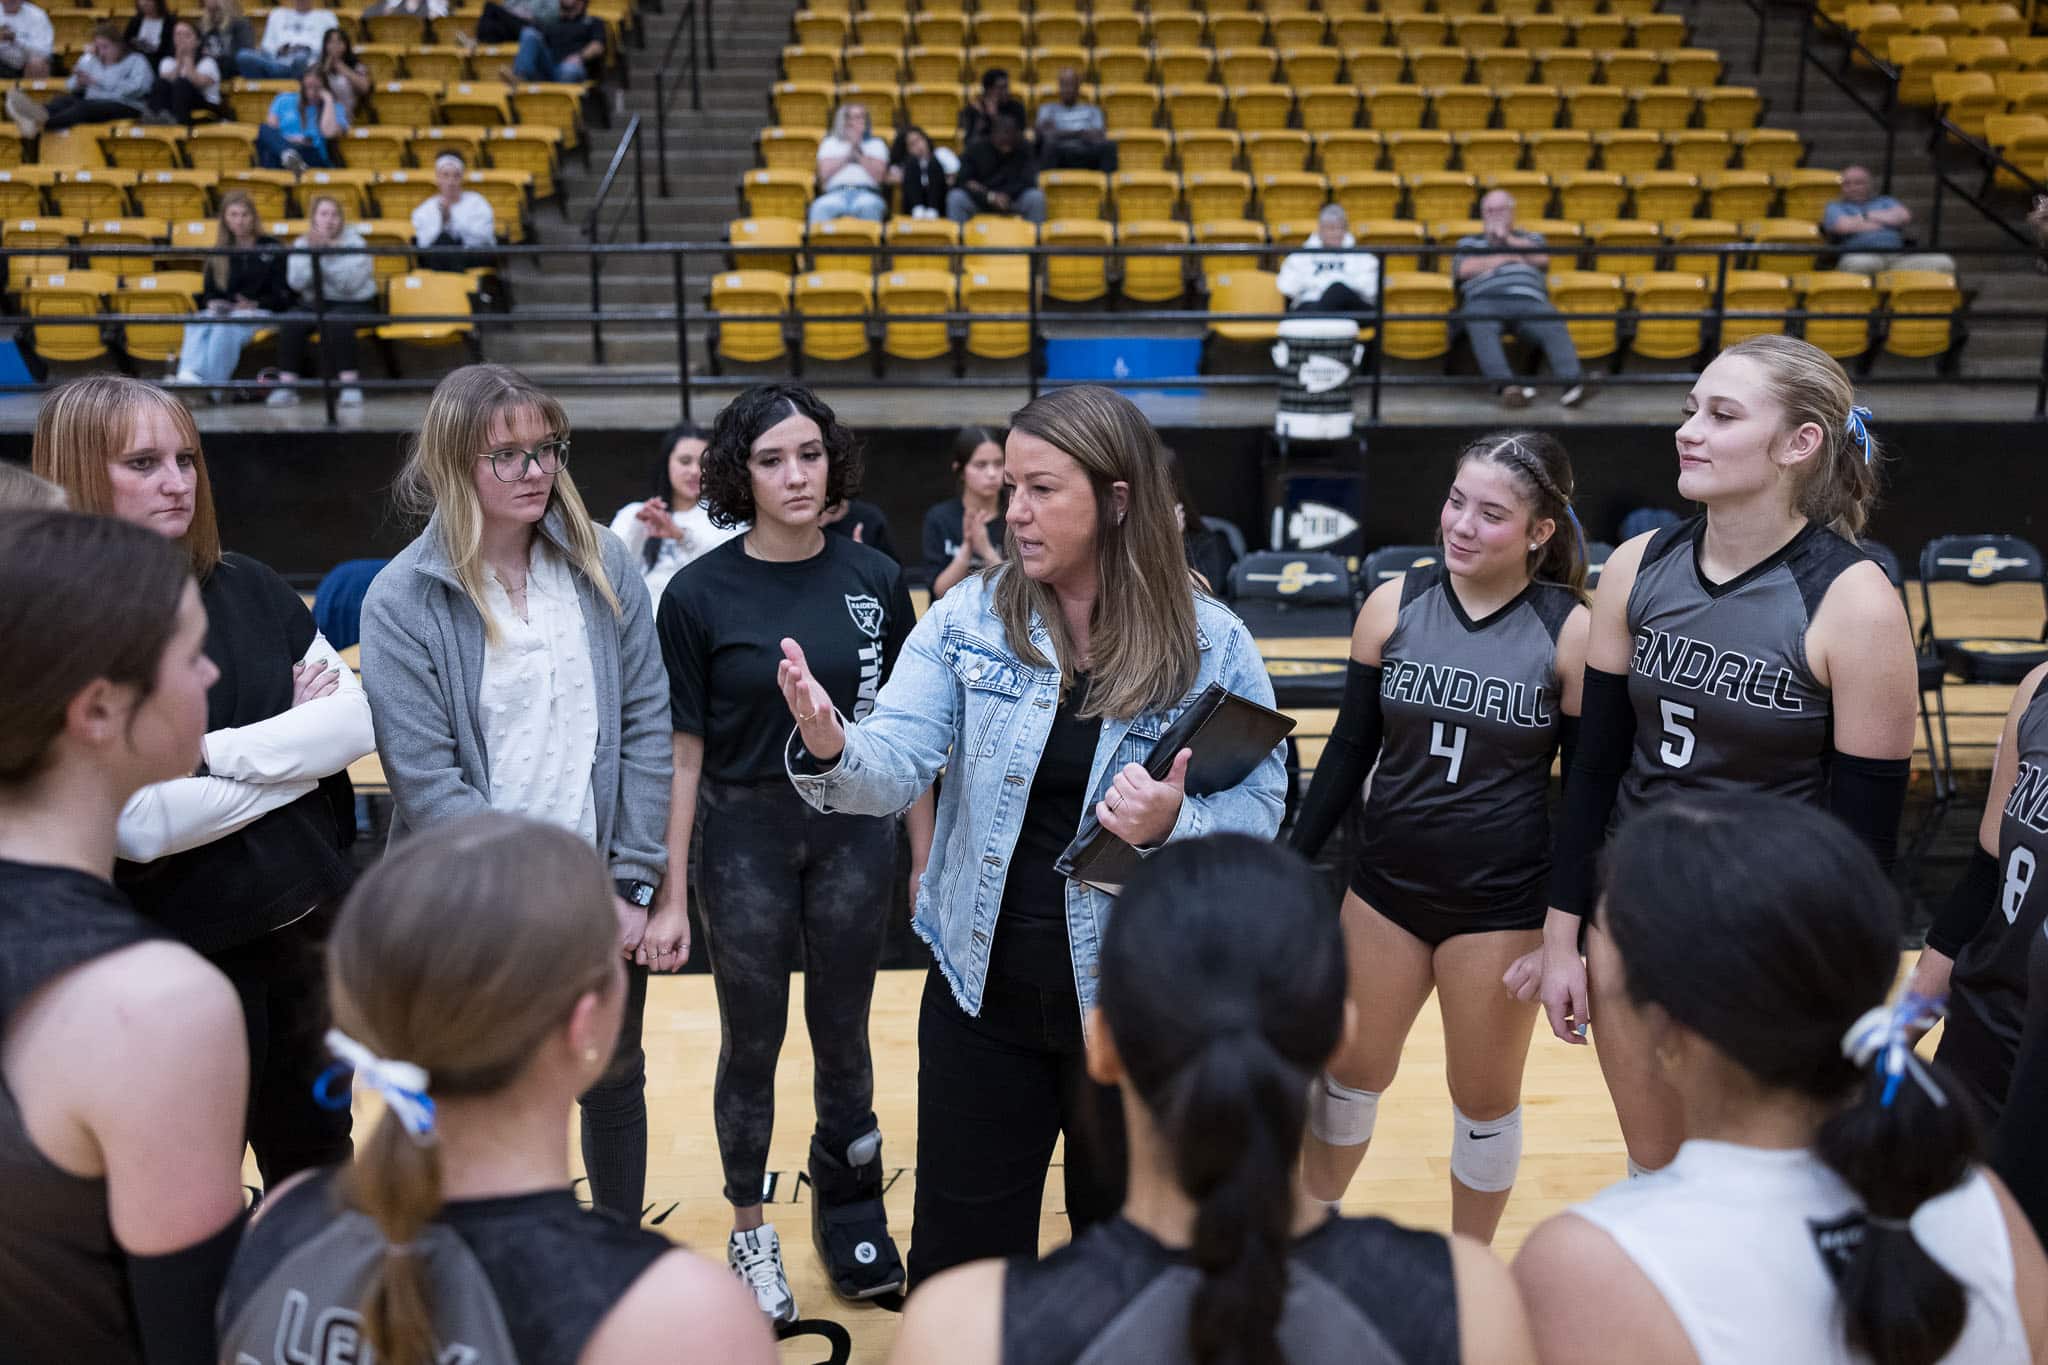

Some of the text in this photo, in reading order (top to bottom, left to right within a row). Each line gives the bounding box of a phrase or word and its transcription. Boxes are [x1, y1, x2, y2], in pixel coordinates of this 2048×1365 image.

[853, 641, 879, 725] DALL
[1380, 659, 1551, 728] RANDALL
[1630, 626, 1802, 712] ANDALL
[1429, 721, 1468, 784] 4
[1659, 699, 1696, 769] 5
[2001, 845, 2037, 925] 8
